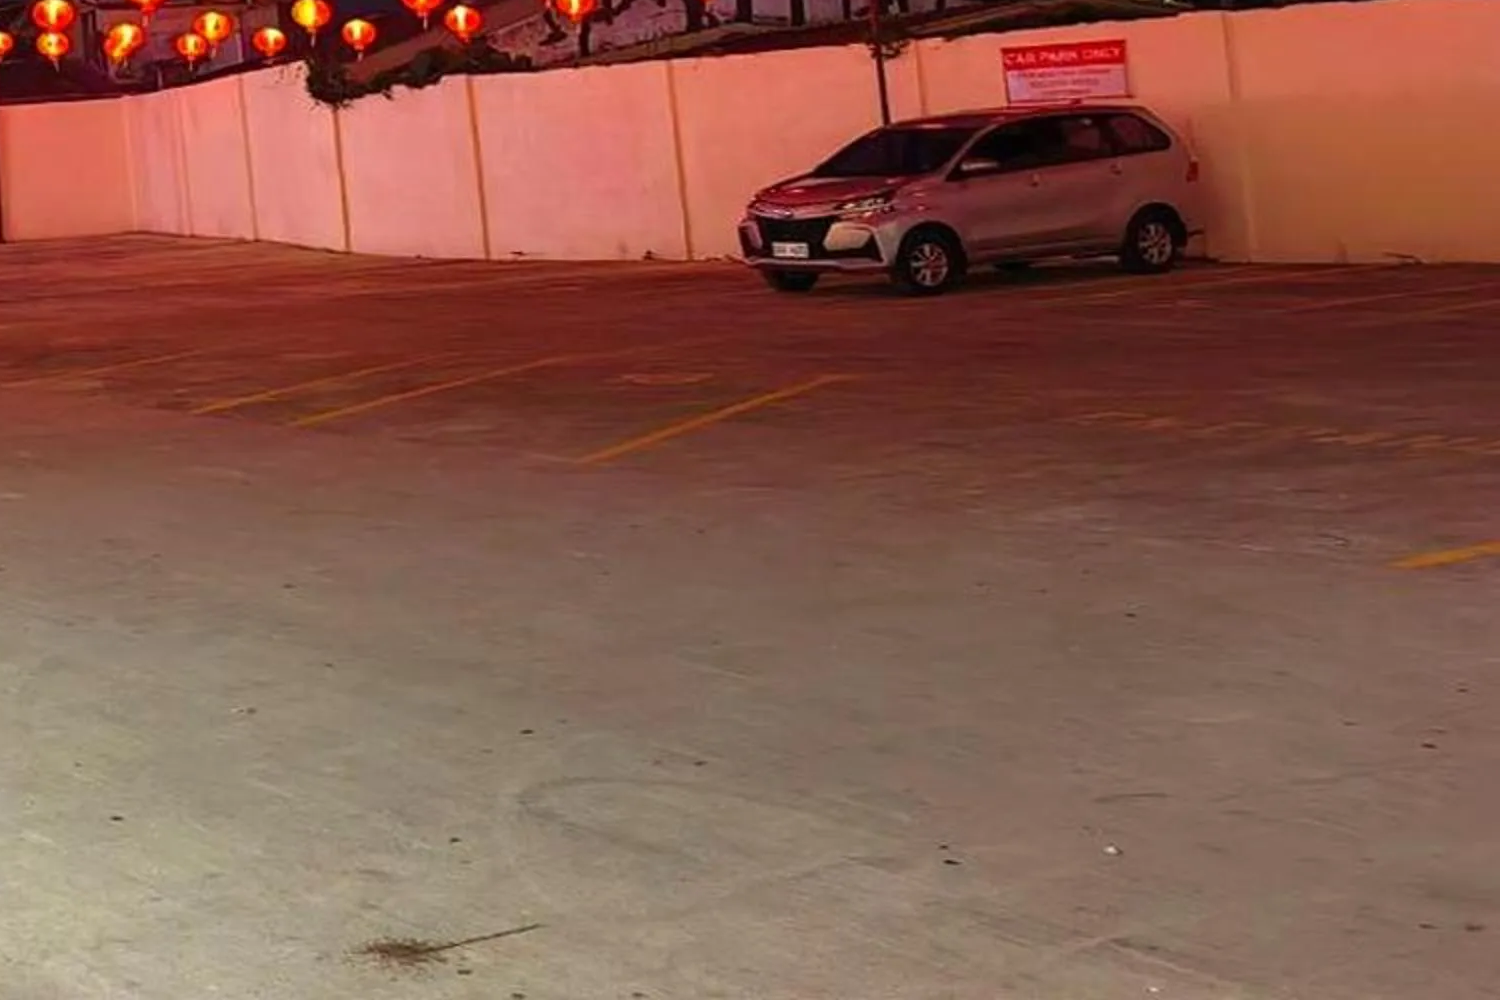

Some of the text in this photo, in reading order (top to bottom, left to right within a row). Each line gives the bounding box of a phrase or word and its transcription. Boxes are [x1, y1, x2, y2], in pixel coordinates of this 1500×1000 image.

[1005, 46, 1120, 65] CAR PARK ONLY
